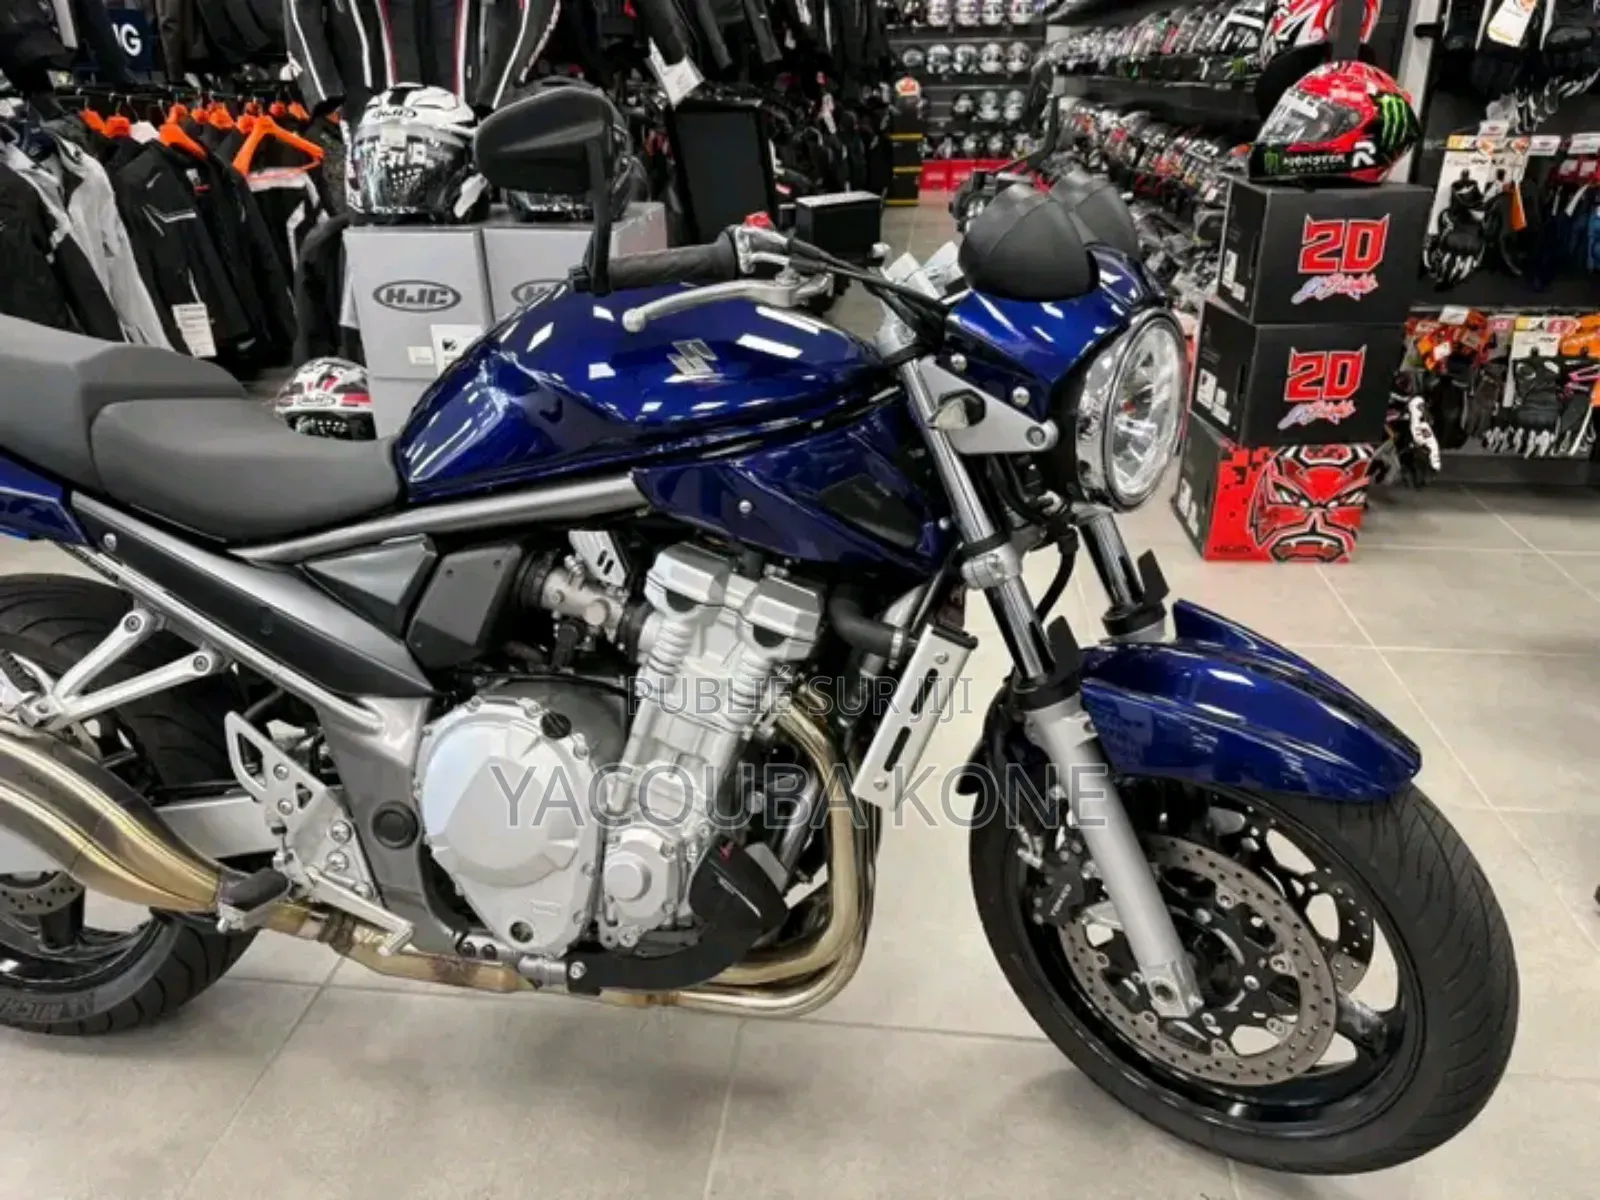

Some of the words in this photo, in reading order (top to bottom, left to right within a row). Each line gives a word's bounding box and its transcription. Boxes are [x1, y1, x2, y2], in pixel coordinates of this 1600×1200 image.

[1298, 213, 1390, 274] 20
[384, 287, 450, 305] HJC
[1284, 344, 1367, 401] 20
